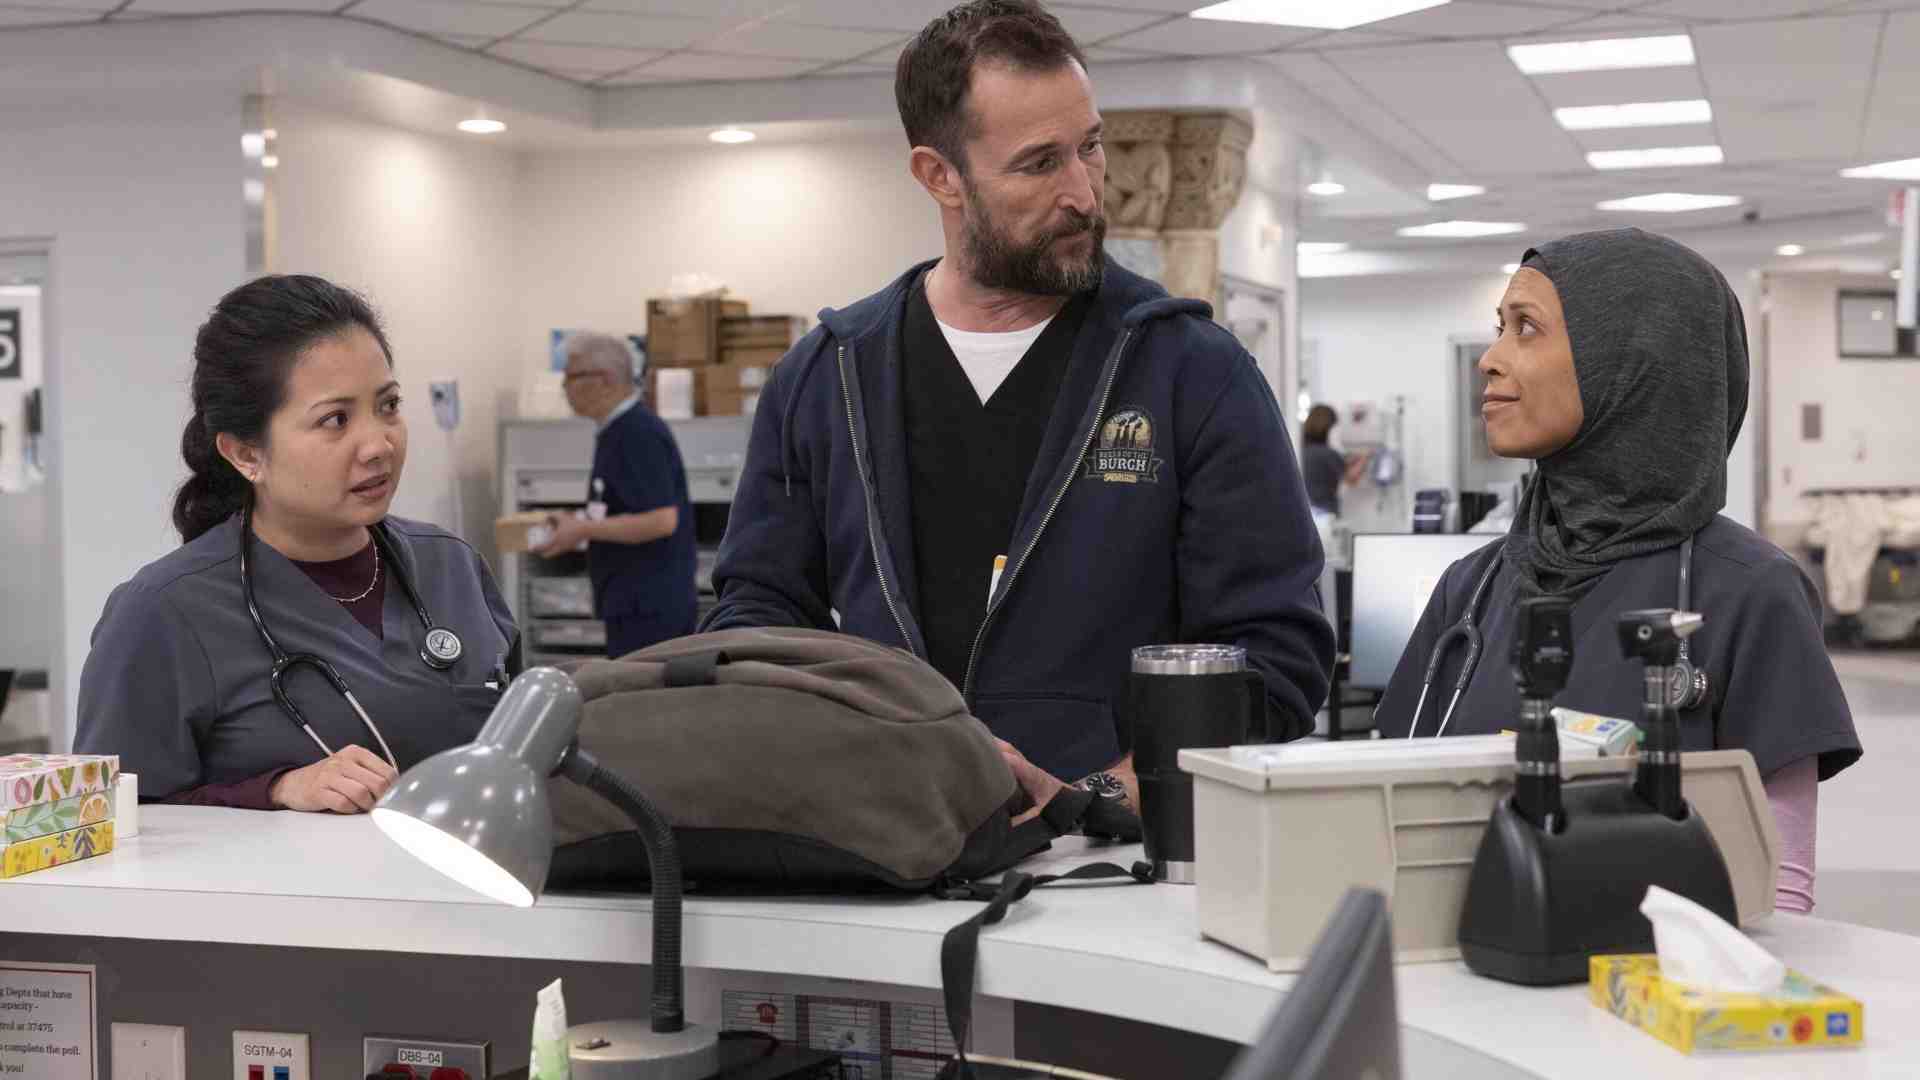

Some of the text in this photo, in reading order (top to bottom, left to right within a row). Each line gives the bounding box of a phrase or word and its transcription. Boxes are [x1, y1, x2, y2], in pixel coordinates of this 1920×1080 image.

[1098, 458, 1146, 472] BURGH
[33, 988, 50, 999] that
[52, 989, 73, 1000] have
[46, 1045, 60, 1054] the
[244, 1044, 293, 1057] SGTM-04
